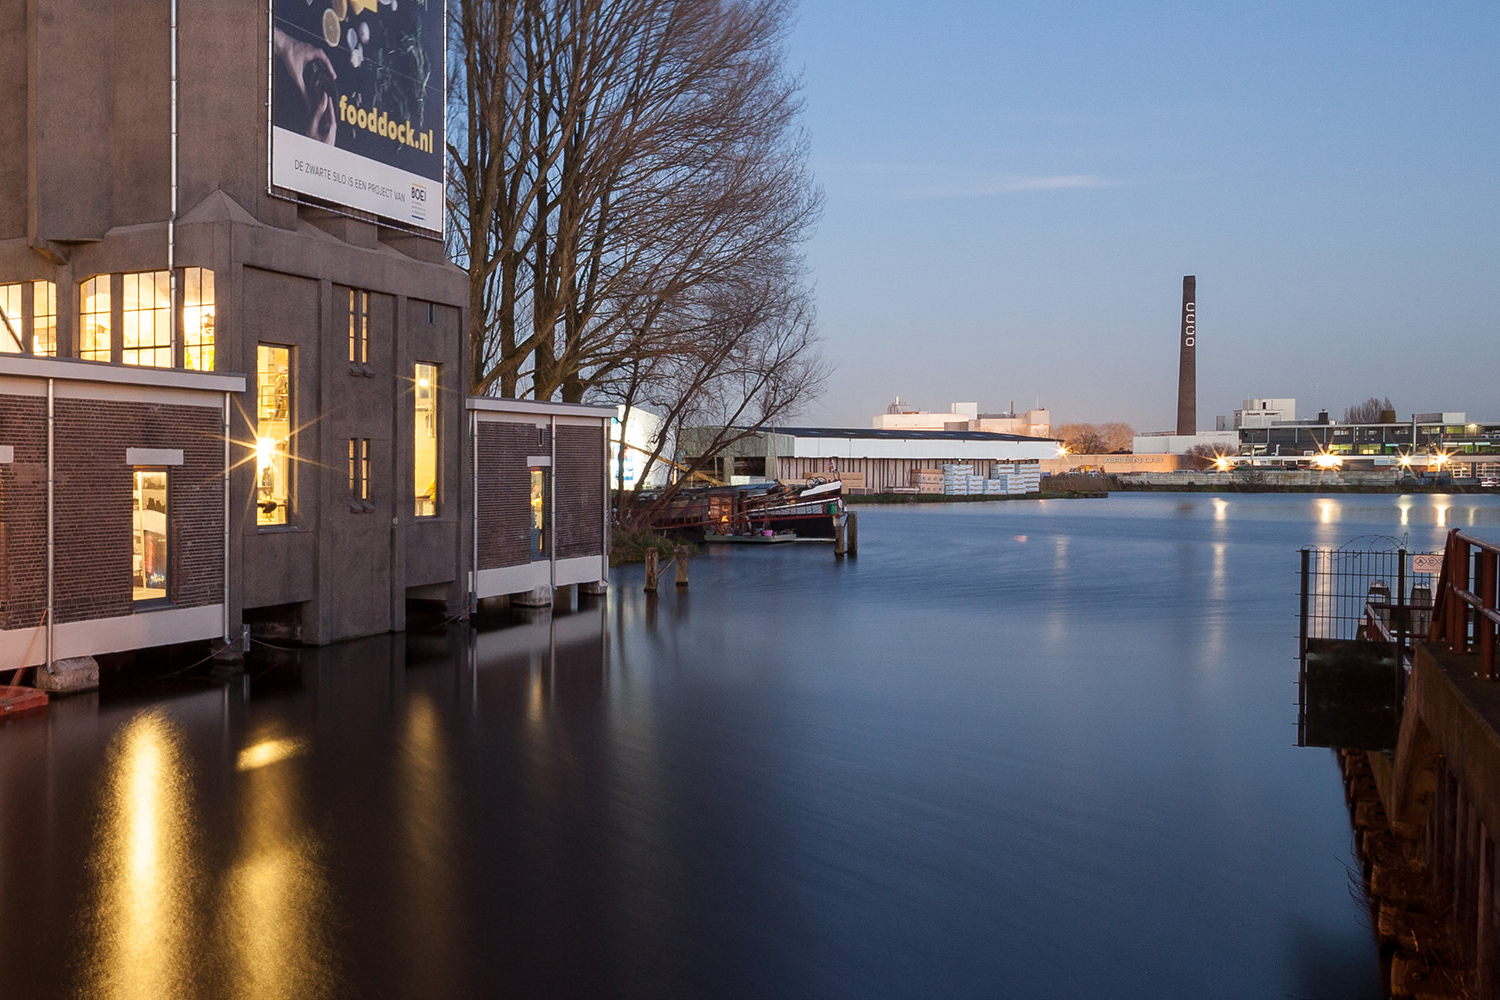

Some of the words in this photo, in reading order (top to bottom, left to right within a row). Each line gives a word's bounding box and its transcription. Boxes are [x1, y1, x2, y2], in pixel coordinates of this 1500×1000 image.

[339, 94, 434, 154] fooddock.nl
[294, 159, 304, 171] DE
[305, 162, 331, 180] ZWARTE
[332, 171, 347, 185] SILO
[354, 178, 367, 191] EEN
[367, 182, 393, 199] PROJECT
[393, 191, 405, 202] VAN
[411, 186, 427, 202] BOEI
